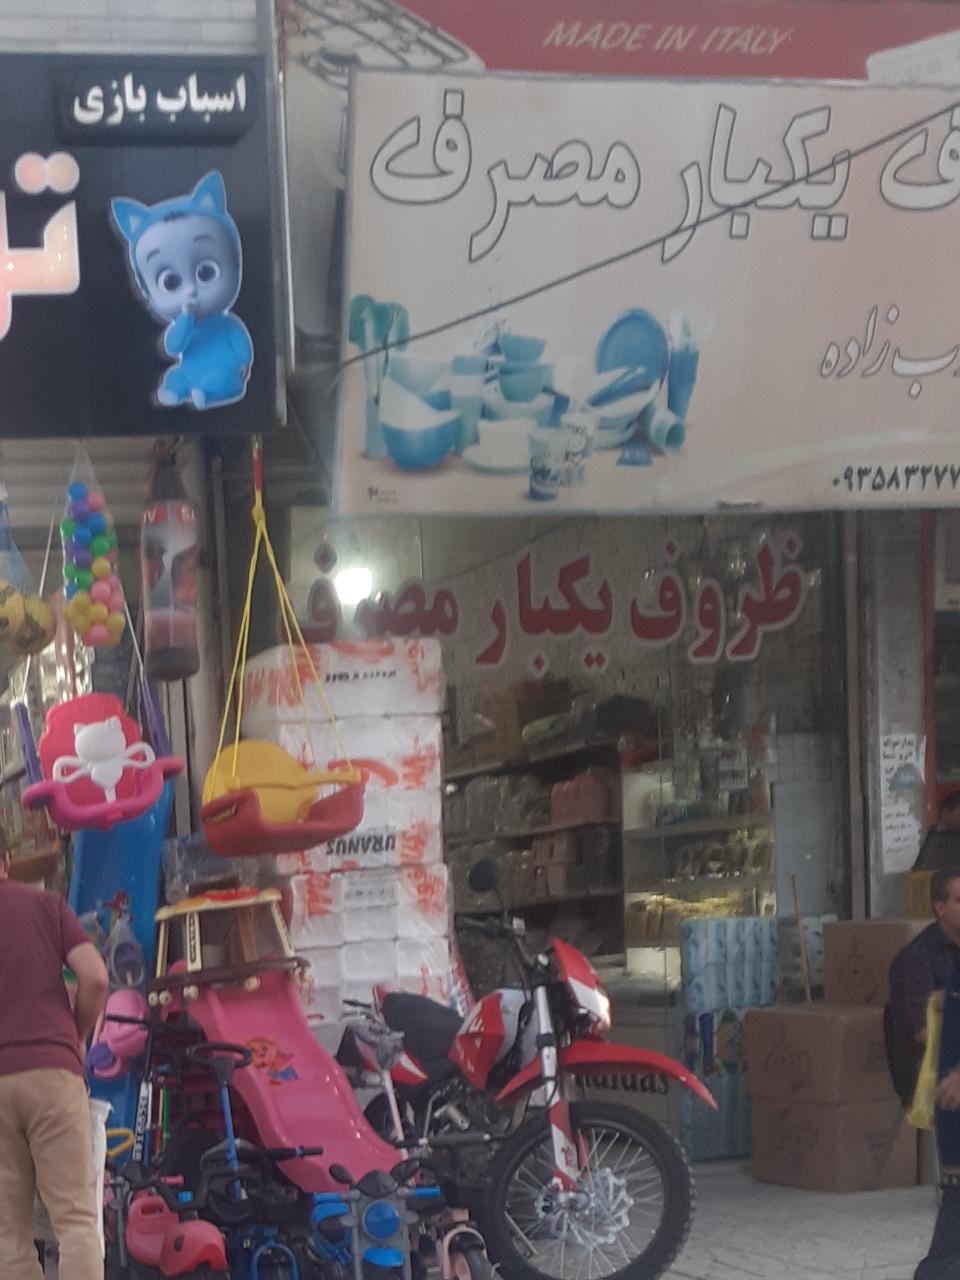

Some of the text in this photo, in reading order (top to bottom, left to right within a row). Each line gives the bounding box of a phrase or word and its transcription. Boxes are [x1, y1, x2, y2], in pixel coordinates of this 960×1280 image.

[542, 20, 794, 55] MADE IN ITALY
[73, 72, 246, 126] اسباب بازی
[370, 89, 641, 263] مصرف
[661, 103, 852, 264] یکبار
[474, 552, 617, 674] یکبار
[628, 532, 808, 664] ظروف
[326, 824, 397, 856] URANUS
